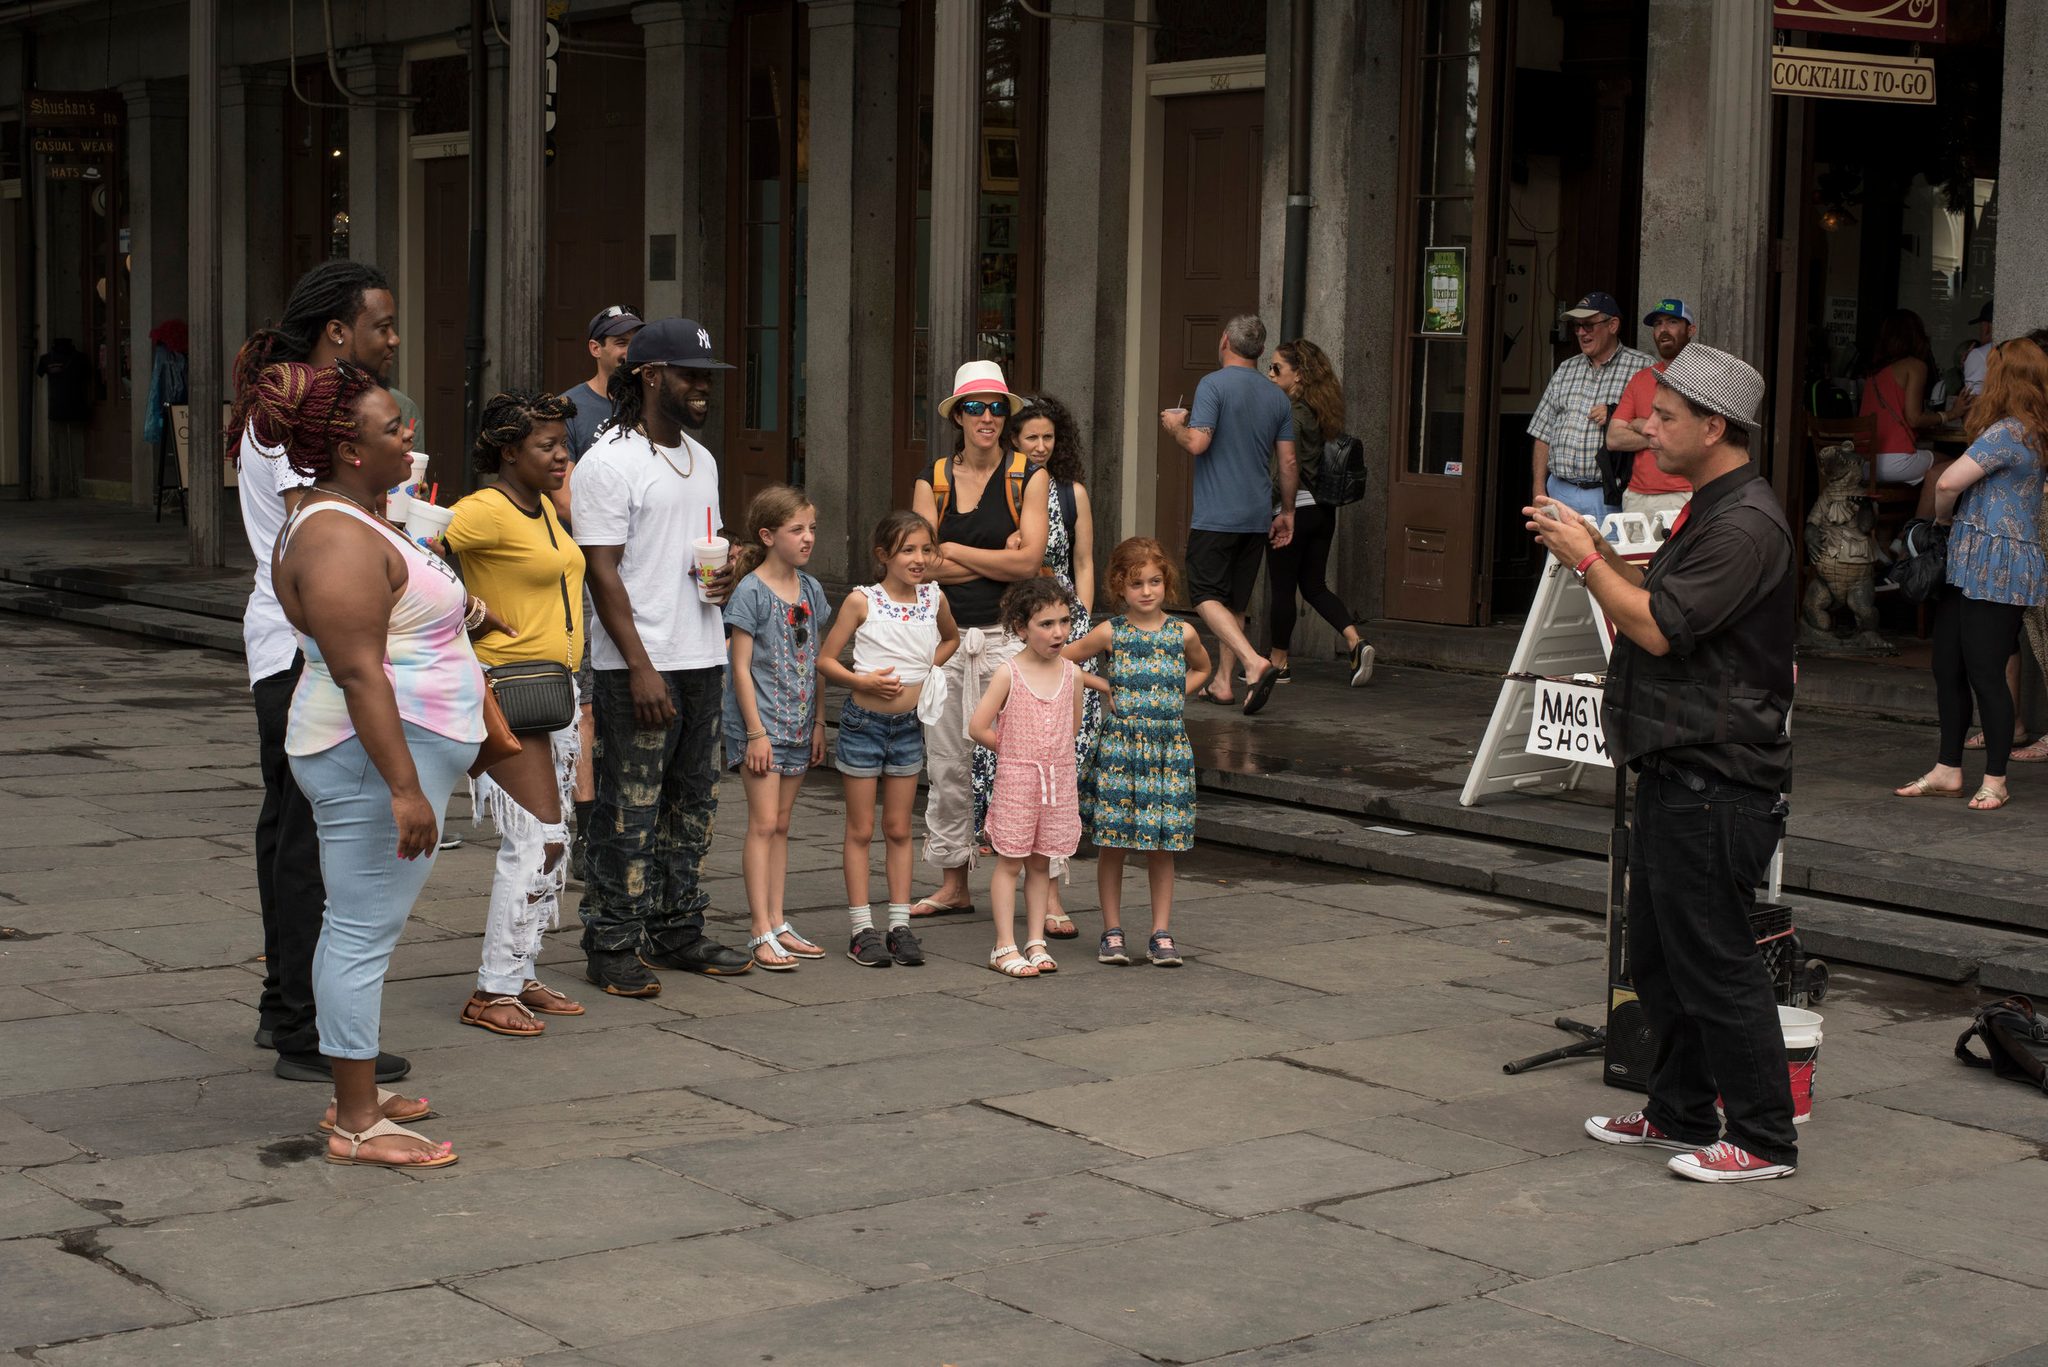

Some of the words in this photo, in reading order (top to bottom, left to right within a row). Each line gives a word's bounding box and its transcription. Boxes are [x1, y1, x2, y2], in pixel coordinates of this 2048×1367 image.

[1773, 62, 1869, 92] COCKTAILS
[1873, 71, 1927, 95] TO-GO
[35, 141, 75, 152] CASUAL
[81, 141, 113, 152] WEAR
[51, 167, 80, 177] HATS
[1540, 688, 1600, 728] MAGI
